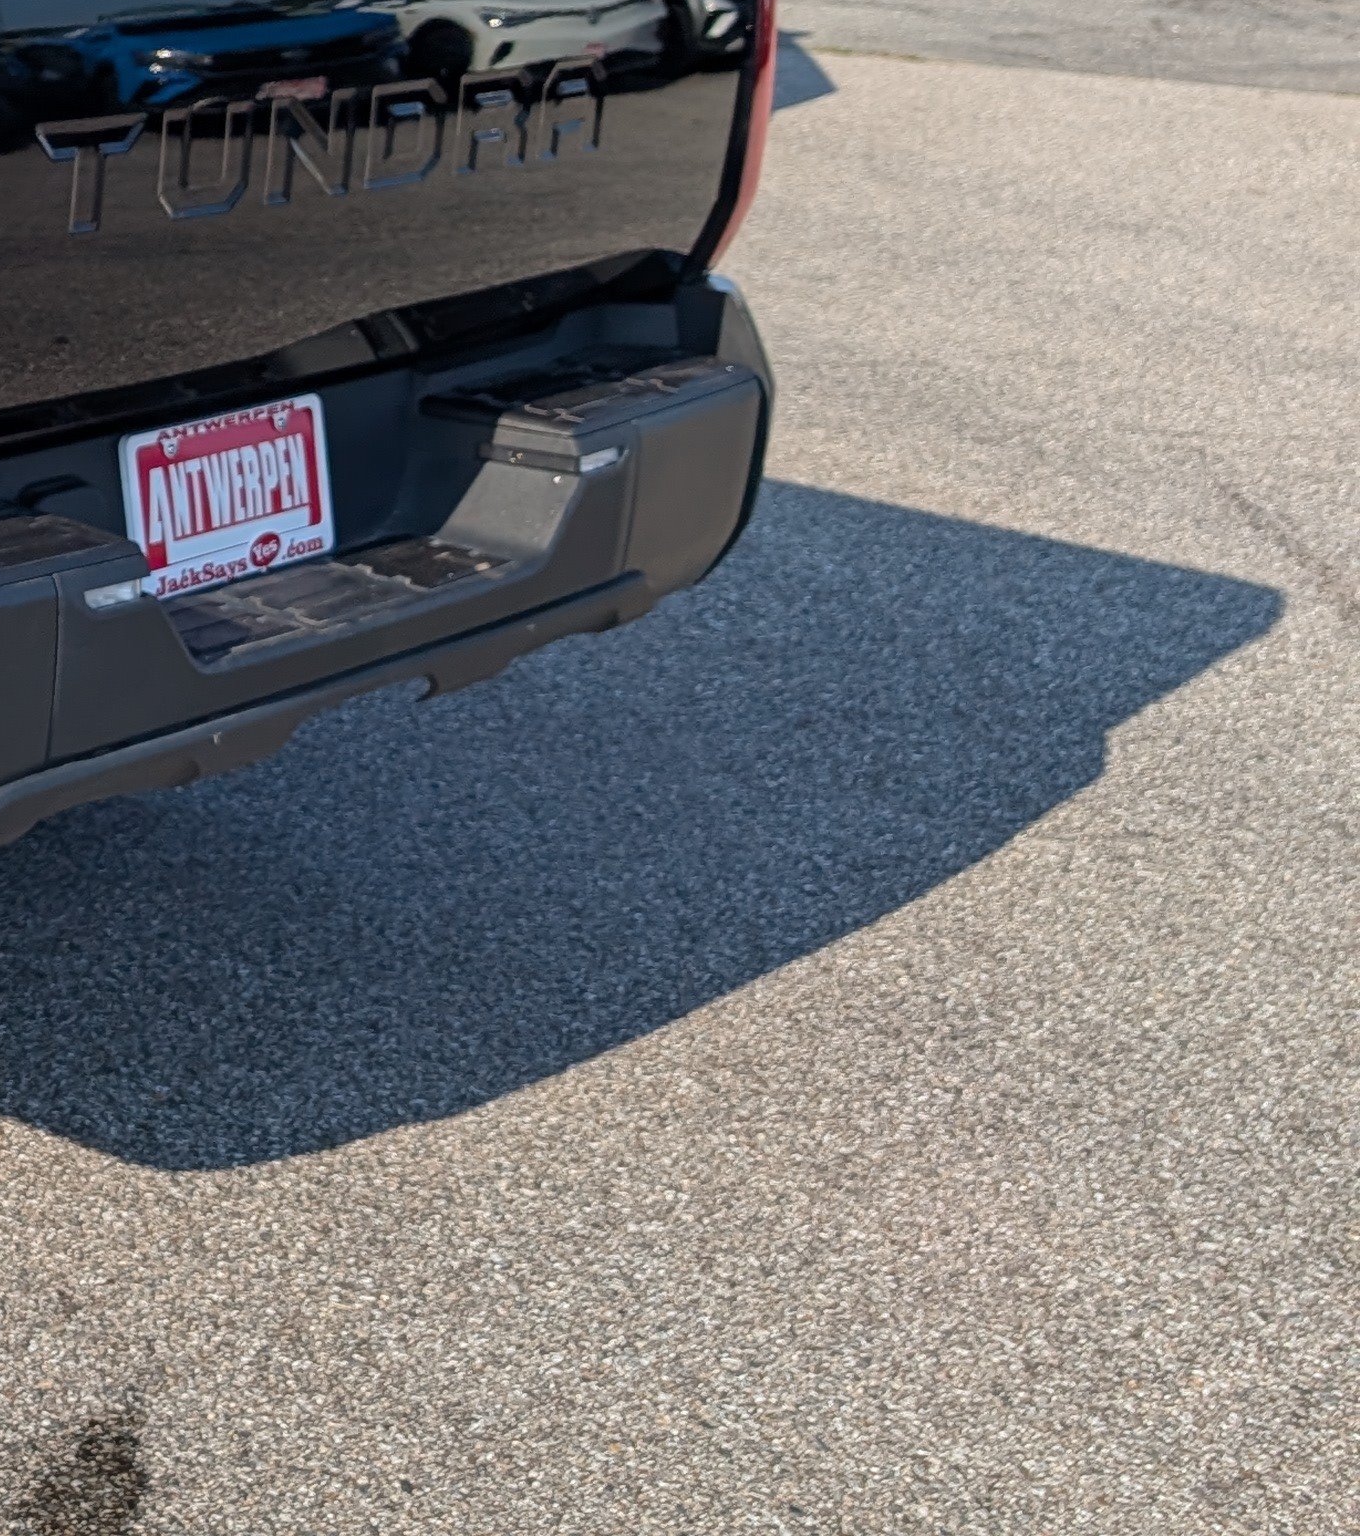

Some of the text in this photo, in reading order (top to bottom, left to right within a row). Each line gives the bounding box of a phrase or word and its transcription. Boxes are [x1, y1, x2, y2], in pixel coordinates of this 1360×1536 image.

[34, 54, 608, 236] TUNDRA
[156, 399, 295, 443] ANTWERPEN
[148, 432, 310, 546] ANTWERPEN
